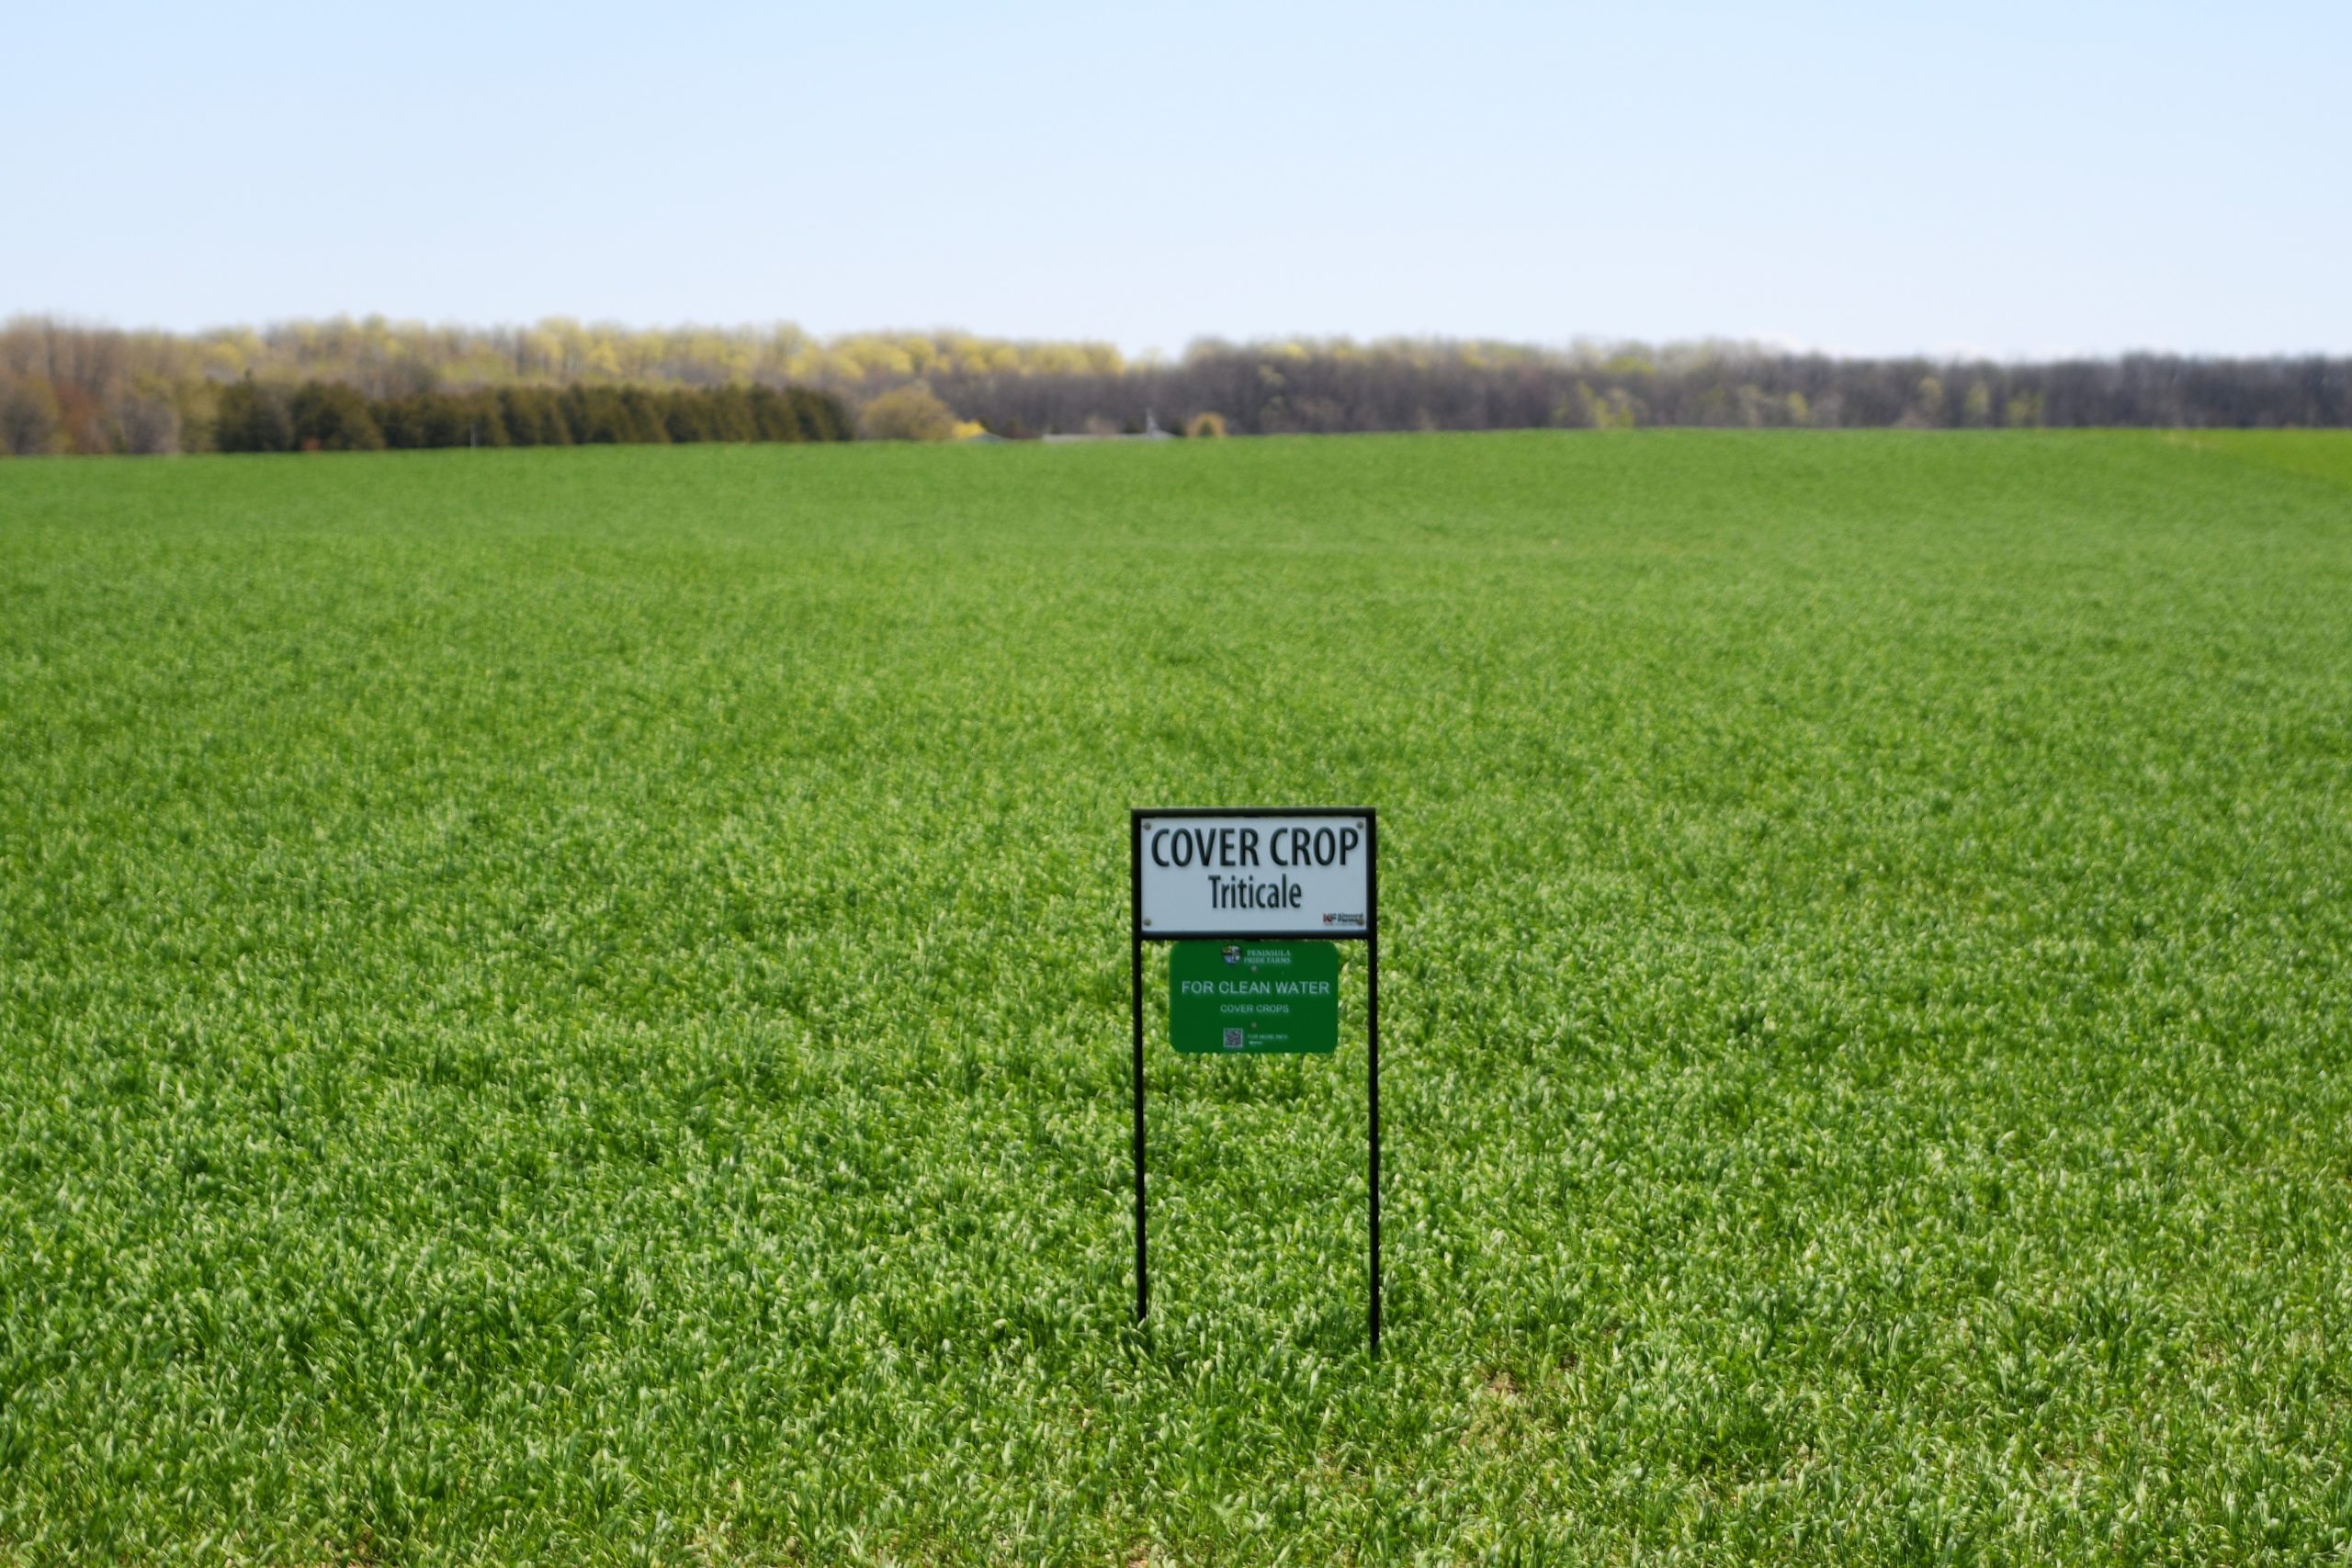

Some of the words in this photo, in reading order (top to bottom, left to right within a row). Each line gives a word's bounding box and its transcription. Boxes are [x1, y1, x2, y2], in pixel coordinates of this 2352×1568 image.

[1151, 828, 1260, 867] COVER
[1269, 827, 1359, 866] CROP
[1208, 874, 1302, 909] Triticale
[1182, 981, 1214, 994] FOR
[1218, 981, 1271, 994] CLEAN
[1275, 981, 1330, 994] WATER
[1220, 1004, 1253, 1013] COVER
[1256, 1004, 1290, 1013] CROPS
